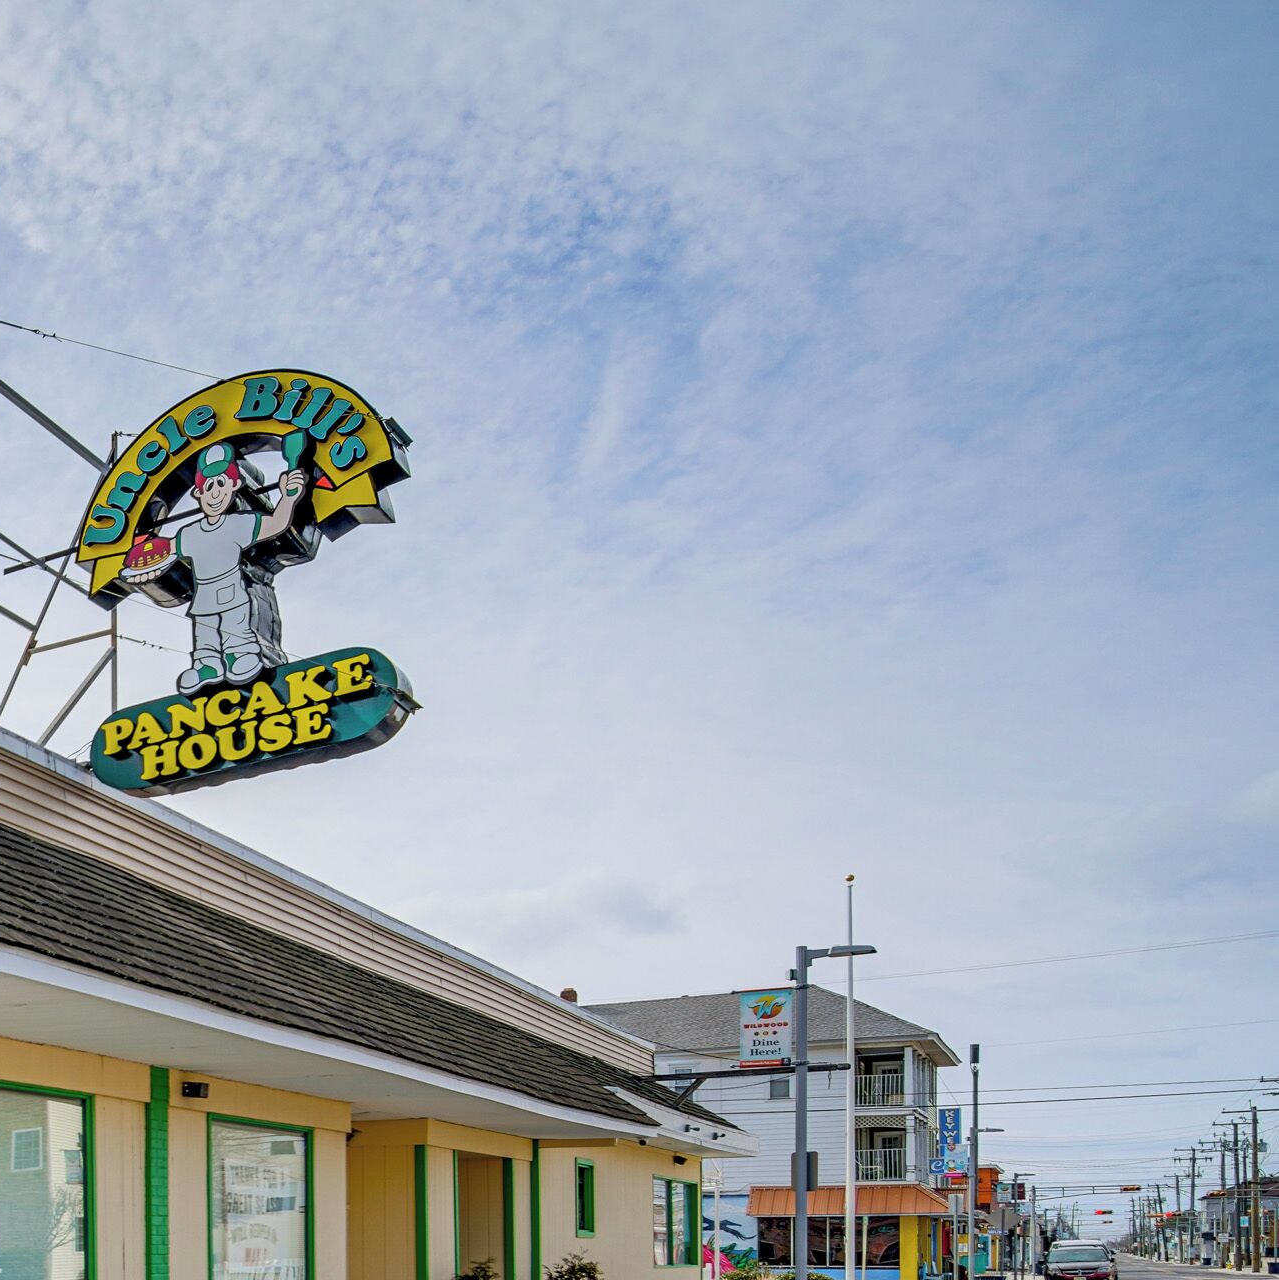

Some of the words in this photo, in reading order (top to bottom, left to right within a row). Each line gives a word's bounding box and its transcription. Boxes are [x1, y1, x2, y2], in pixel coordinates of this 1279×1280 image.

[85, 404, 217, 546] Uncle
[235, 375, 366, 469] Bill's
[101, 653, 375, 756] PANCAKE
[140, 703, 332, 780] HOUSE
[743, 1021, 789, 1029] WILDWOOD
[752, 1039, 780, 1047] Dine
[750, 1047, 782, 1057] Here!
